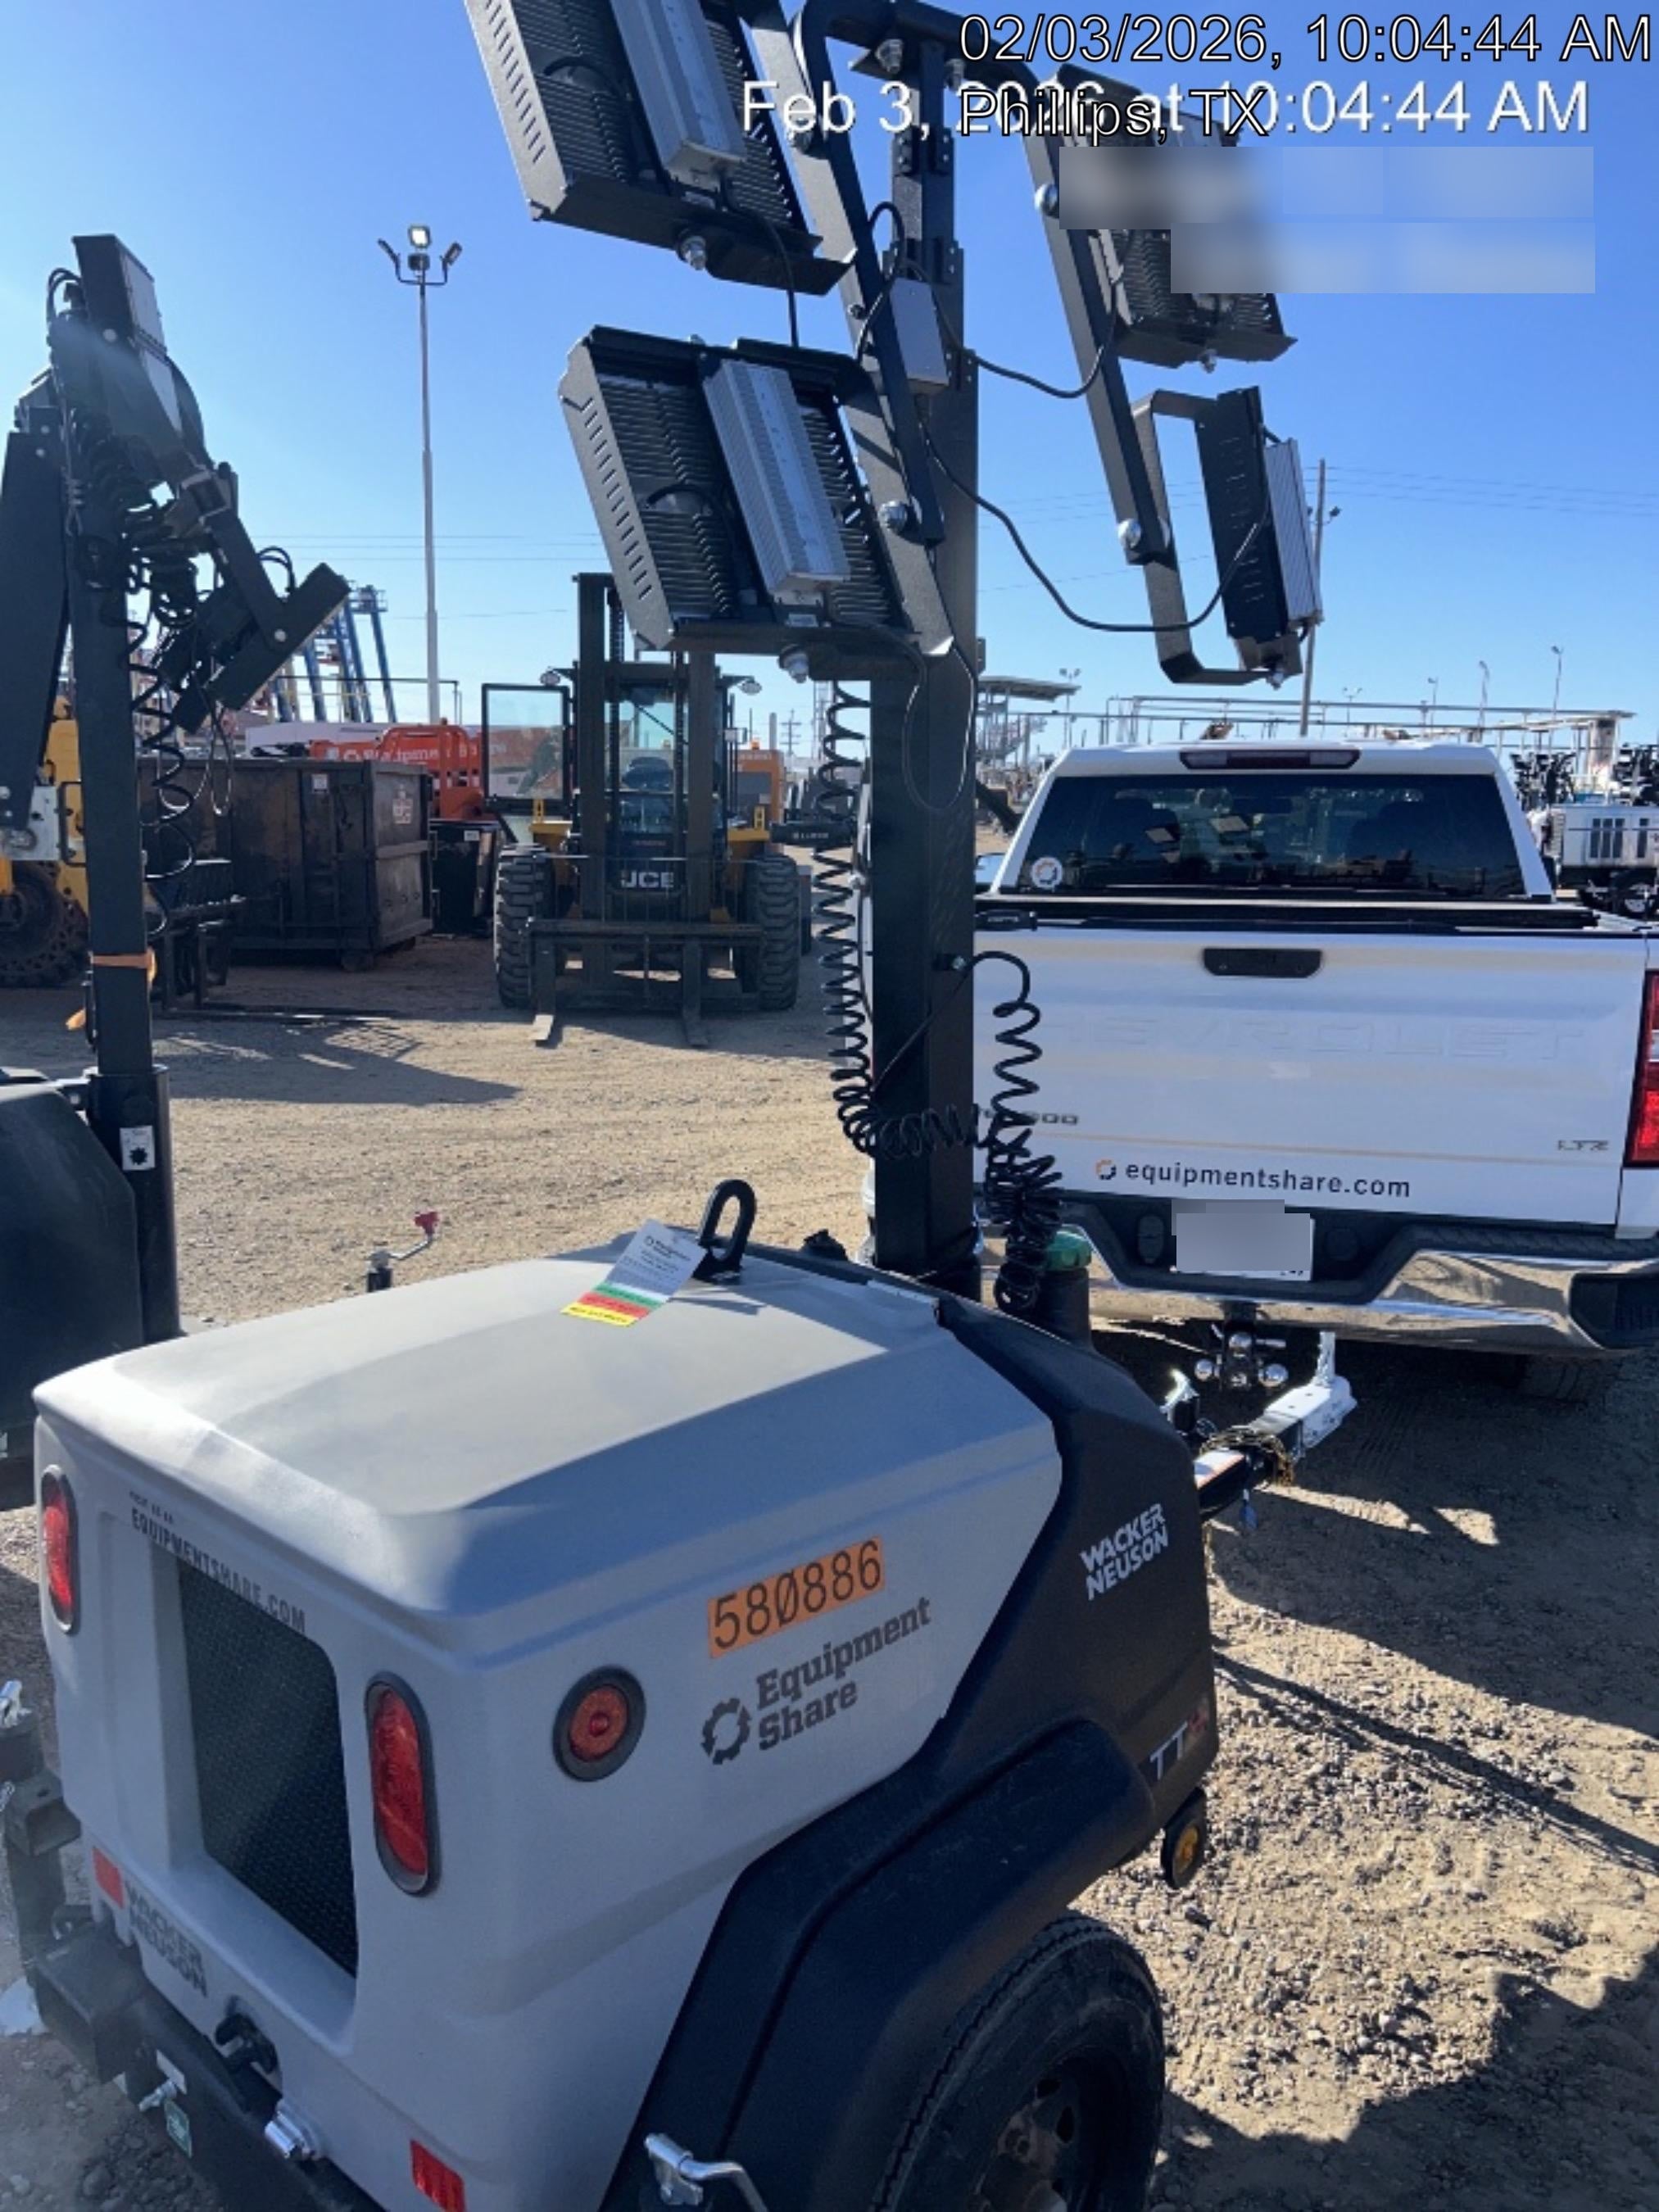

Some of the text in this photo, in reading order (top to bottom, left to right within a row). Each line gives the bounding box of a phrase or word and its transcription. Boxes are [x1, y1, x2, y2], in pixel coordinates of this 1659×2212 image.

[1124, 1162, 1411, 1199] equipmentshare.com
[131, 1506, 306, 1634] EQUIPMENTSHARE.COM
[1079, 1503, 1166, 1572] WACKER
[1086, 1525, 1169, 1601] NEUSON
[711, 1538, 883, 1651] 580886
[755, 1594, 932, 1711] Equipment
[757, 1681, 859, 1751] Share
